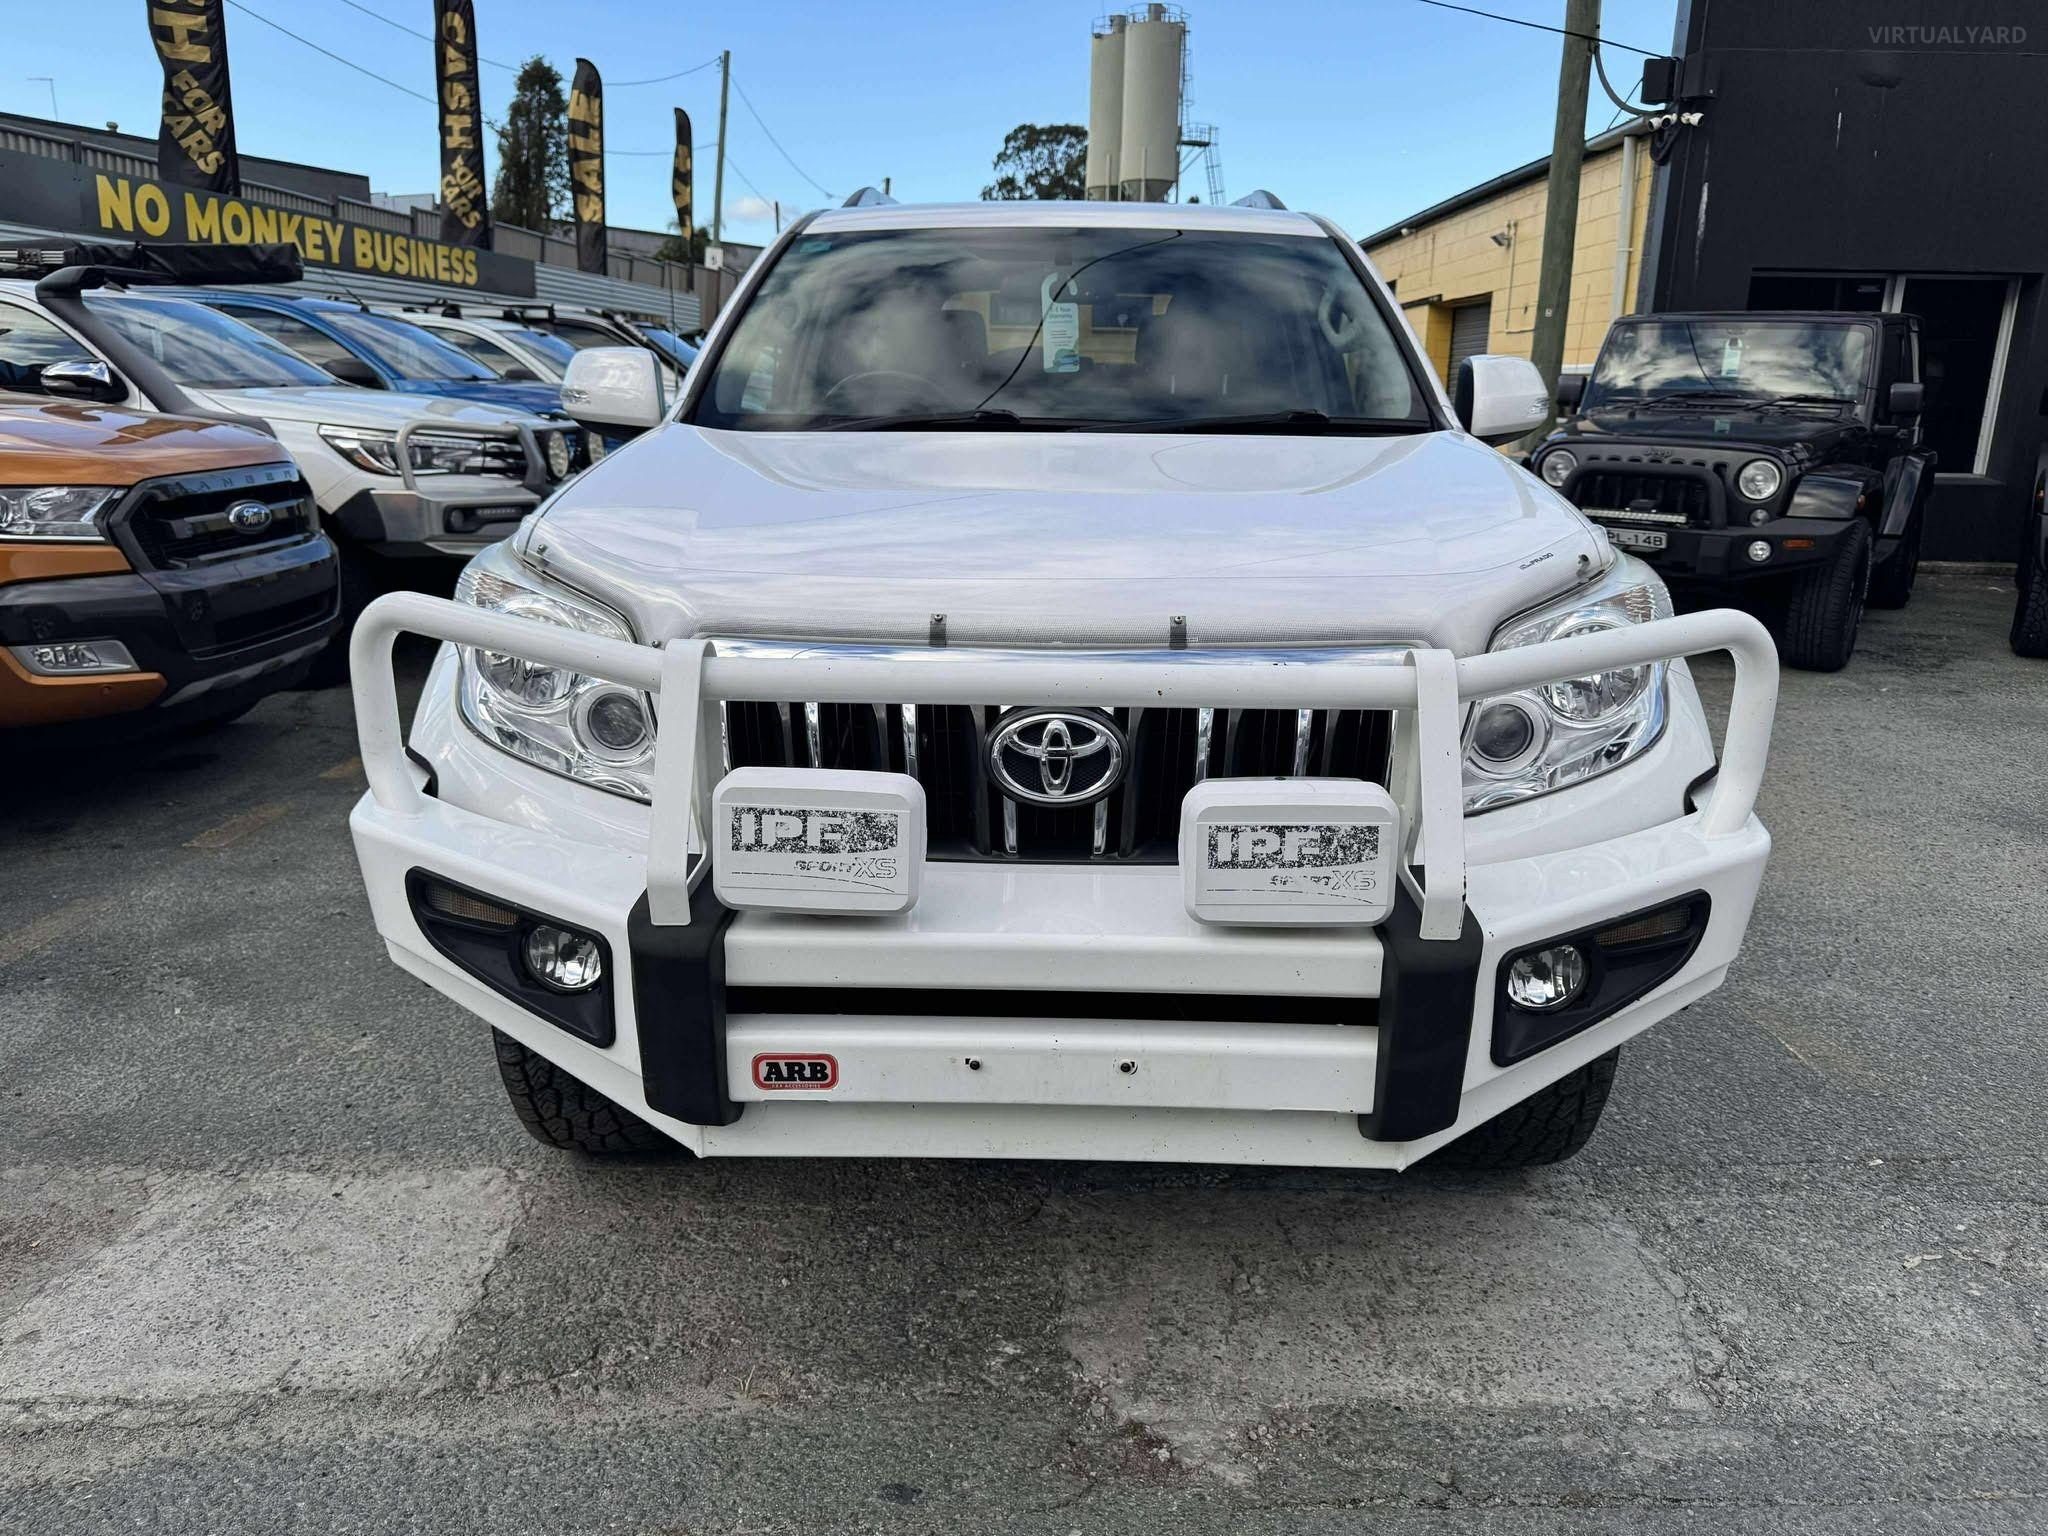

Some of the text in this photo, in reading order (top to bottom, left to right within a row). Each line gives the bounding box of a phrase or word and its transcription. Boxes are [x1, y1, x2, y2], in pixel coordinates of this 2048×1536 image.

[442, 11, 474, 149] CASH
[568, 88, 604, 224] SALE
[442, 173, 482, 229] CARS
[96, 174, 479, 287] NO MONKEY BUSINESS
[741, 811, 844, 848] IPF
[1217, 830, 1321, 862] IPF
[853, 856, 897, 879] XS
[1332, 869, 1377, 891] XS
[763, 1061, 829, 1082] ARB
